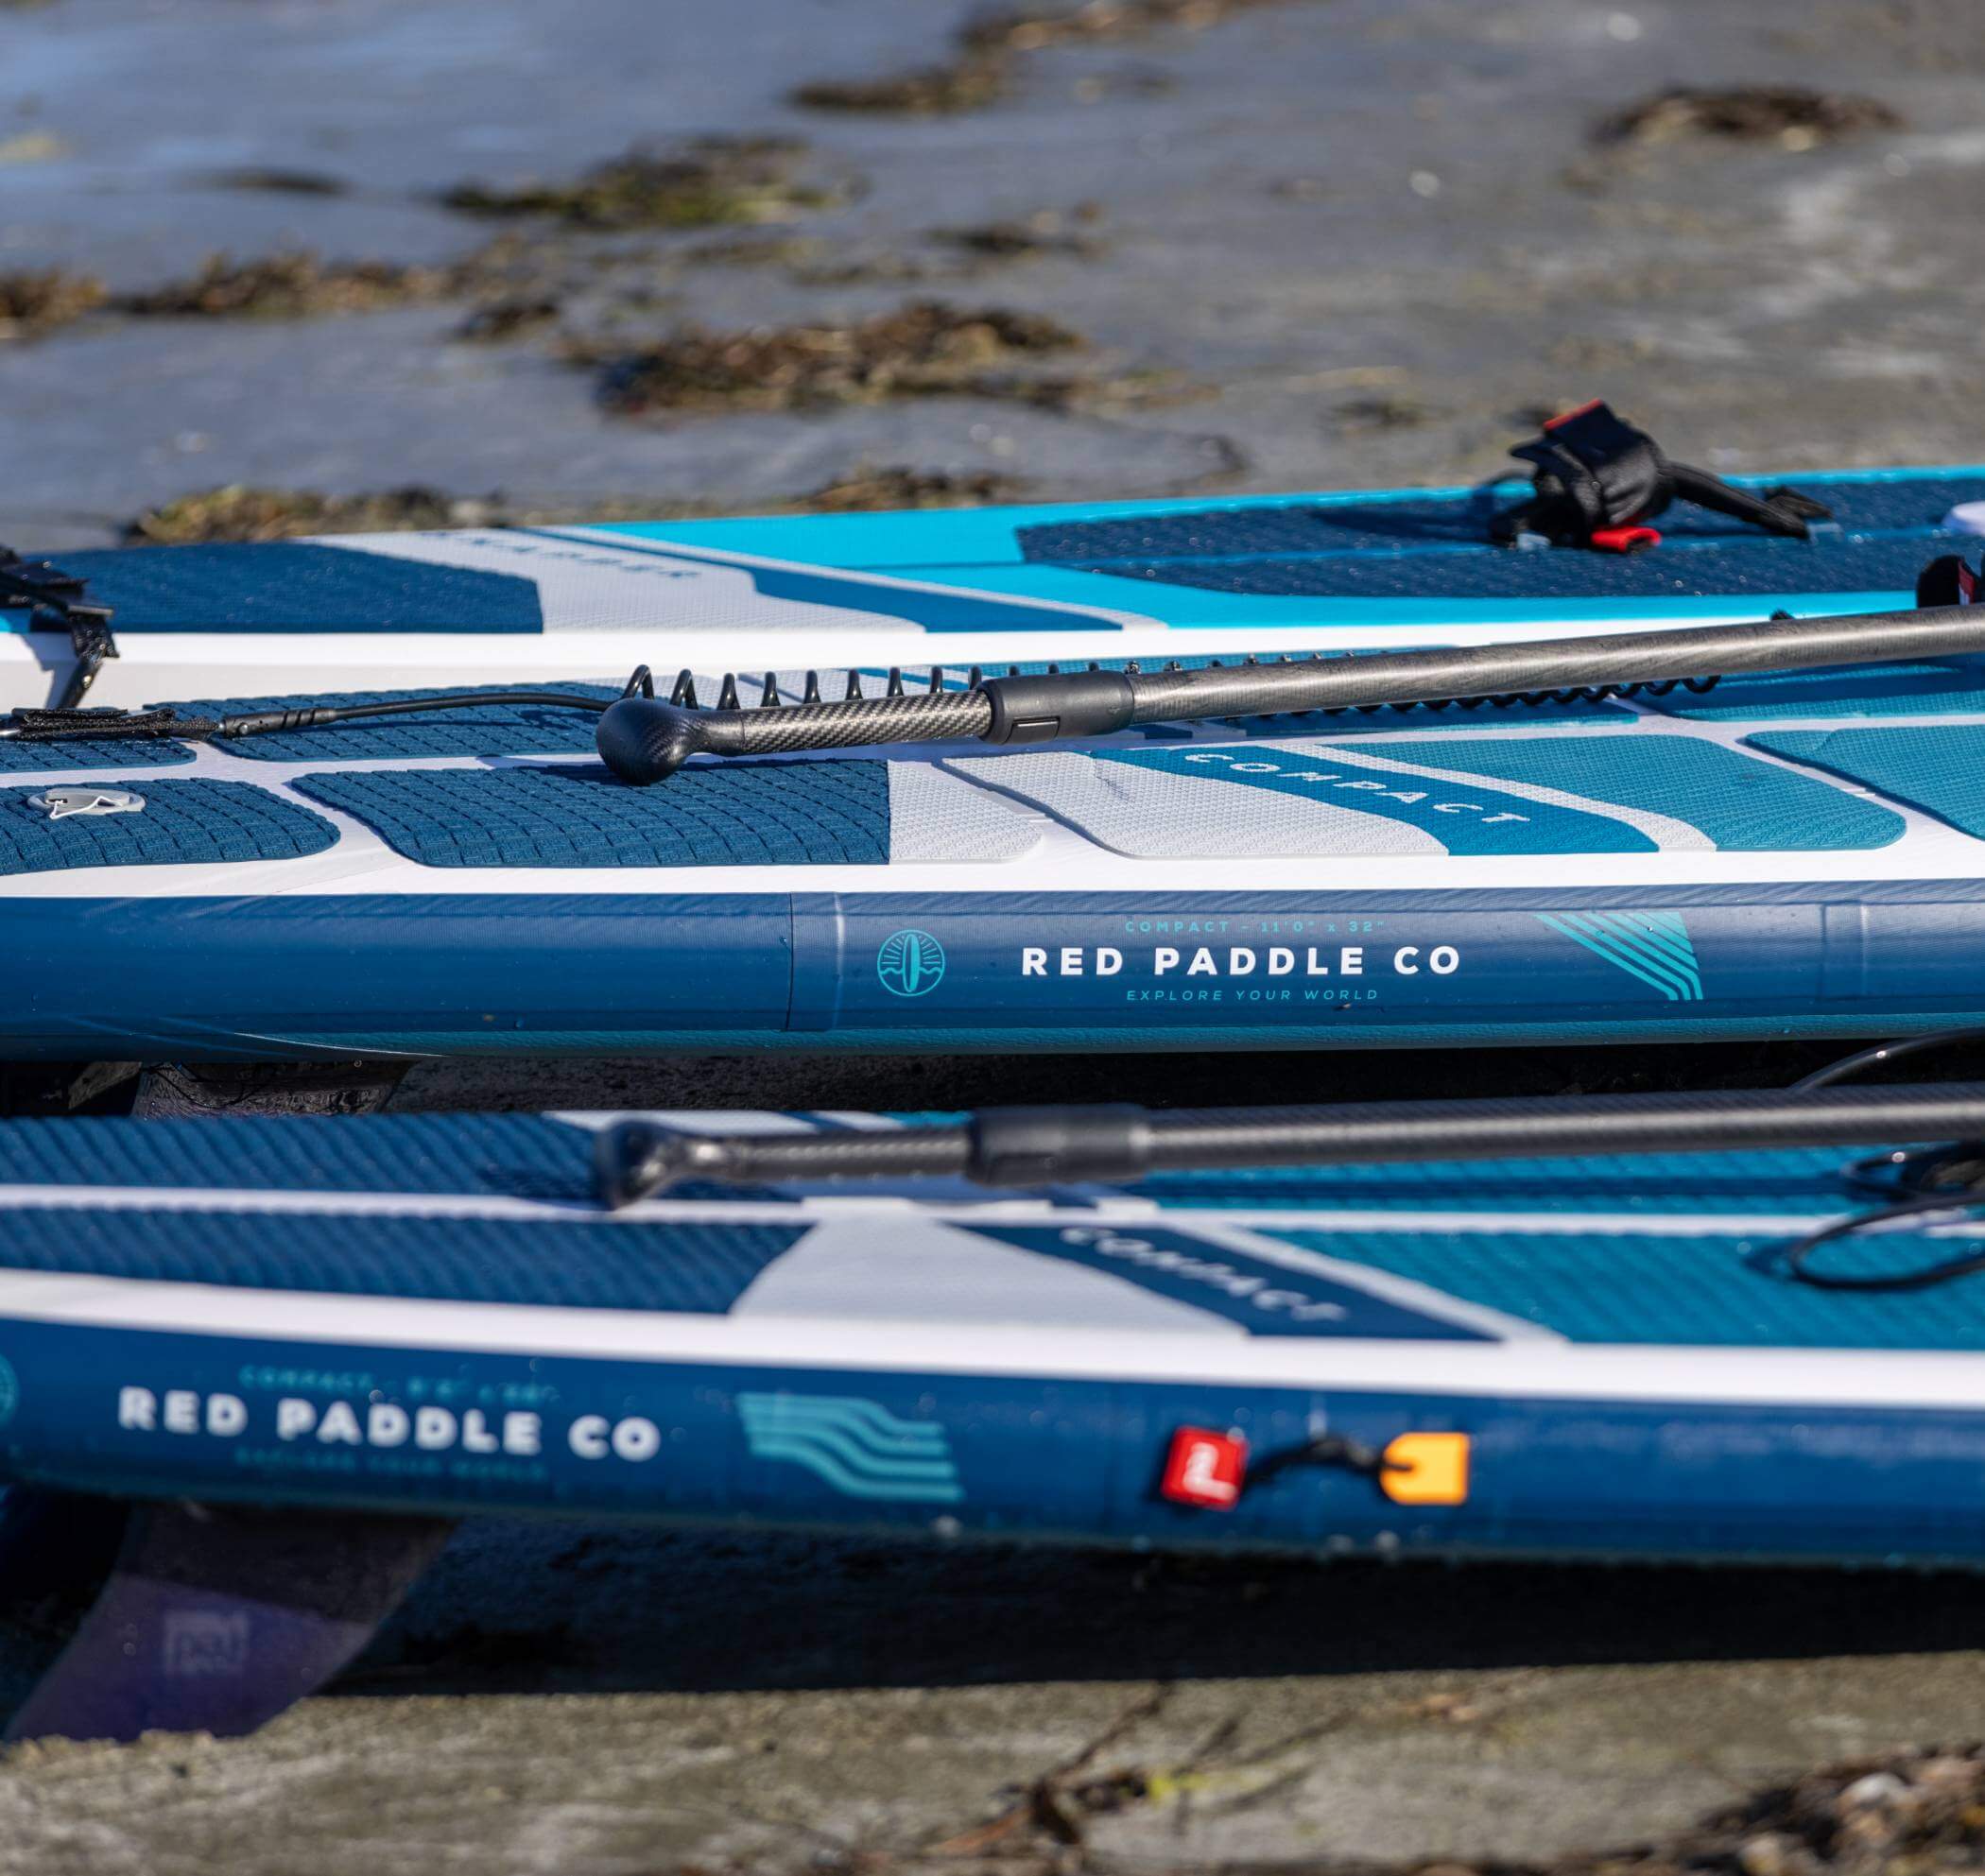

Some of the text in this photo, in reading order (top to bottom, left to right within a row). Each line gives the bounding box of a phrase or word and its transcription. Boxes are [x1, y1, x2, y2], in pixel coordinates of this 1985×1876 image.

[1184, 754, 1531, 823] COMPACT
[1125, 921, 1229, 933] COMPACT
[1022, 946, 1459, 975] RED PADDLE CO
[1126, 990, 1378, 1001] EXPLORE YOUR WORLD
[118, 1385, 661, 1462] RED PADDLE CO
